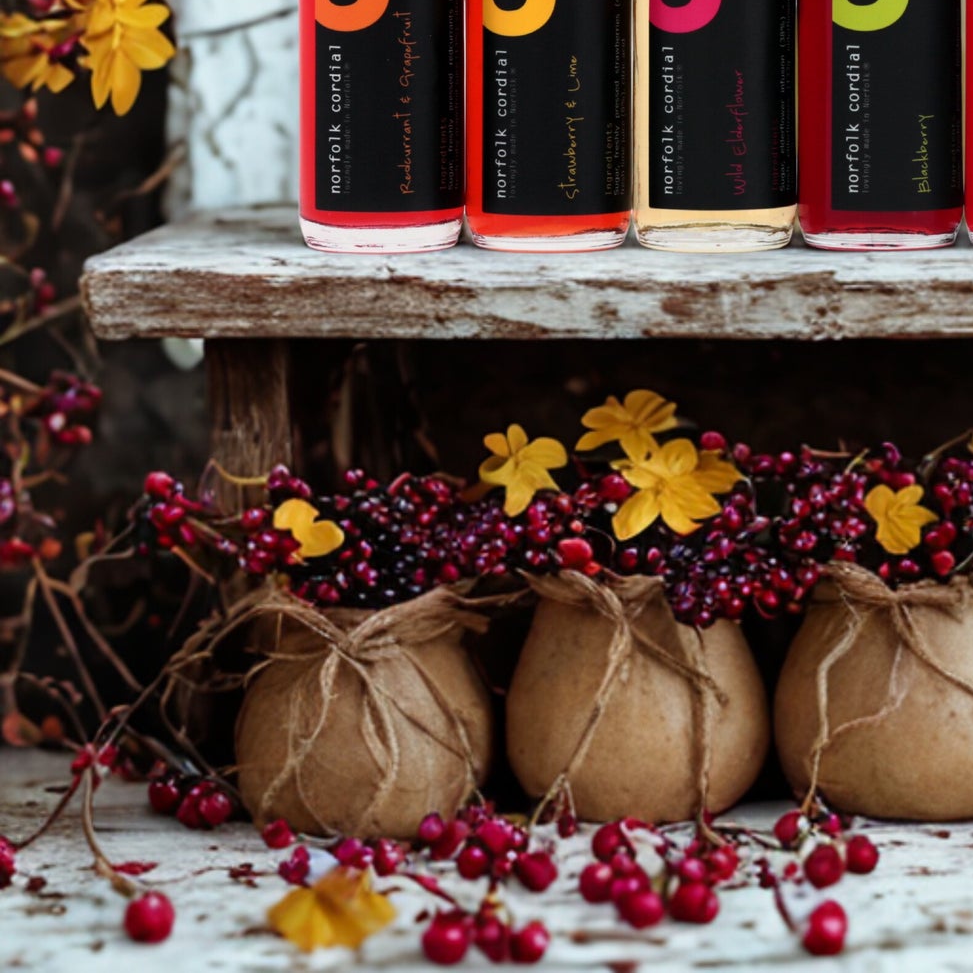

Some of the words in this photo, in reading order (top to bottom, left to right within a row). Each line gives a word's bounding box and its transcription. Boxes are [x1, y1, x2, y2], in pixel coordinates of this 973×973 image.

[329, 45, 342, 113] cordial
[392, 11, 421, 87] Grapefruit
[568, 55, 580, 91] Lime
[662, 46, 674, 113] cordial
[846, 44, 860, 112] cordial
[399, 96, 410, 104] &
[495, 50, 508, 117] cordial
[721, 68, 749, 156] Elderflower
[863, 113, 870, 122] in
[344, 114, 351, 123] in
[510, 118, 516, 127] in
[676, 115, 683, 124] in
[329, 124, 341, 194] norfolk
[392, 112, 414, 194] Redcurrant
[495, 129, 507, 198] norfolk
[557, 116, 584, 199] Strawberry
[605, 123, 613, 195] Ingredients
[662, 125, 673, 194] norfolk
[721, 164, 747, 195] Wild
[846, 124, 859, 193] norfolk
[863, 154, 871, 193] lovingly
[912, 114, 935, 193] Blackberry
